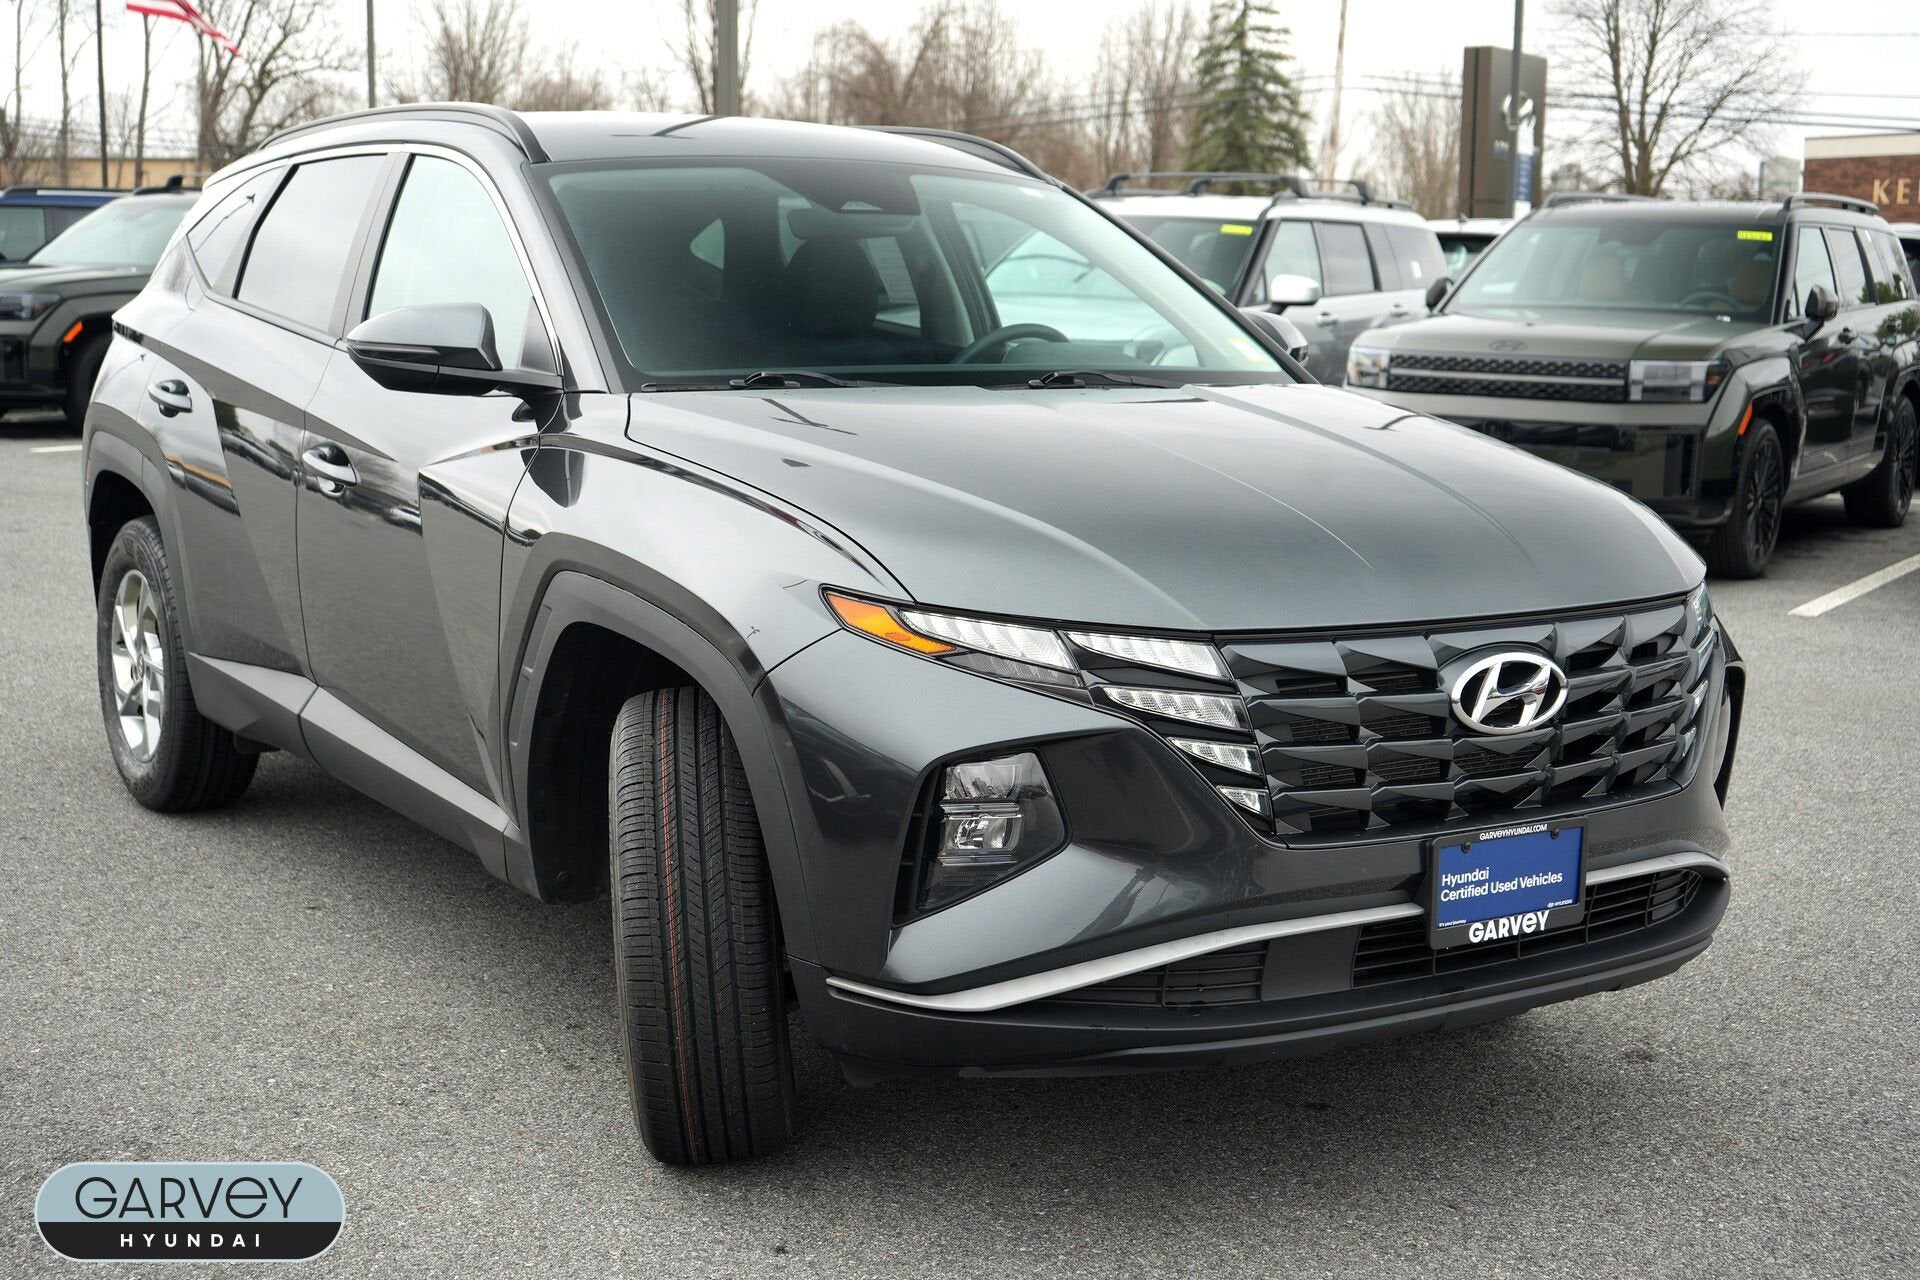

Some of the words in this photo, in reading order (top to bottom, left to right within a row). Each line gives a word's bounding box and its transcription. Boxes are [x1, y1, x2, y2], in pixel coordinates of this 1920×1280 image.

[1872, 177, 1920, 205] KE
[1440, 884, 1489, 902] Certified
[1490, 877, 1518, 894] Used
[1519, 871, 1563, 889] Vehicles
[1441, 867, 1490, 887] Hyundai
